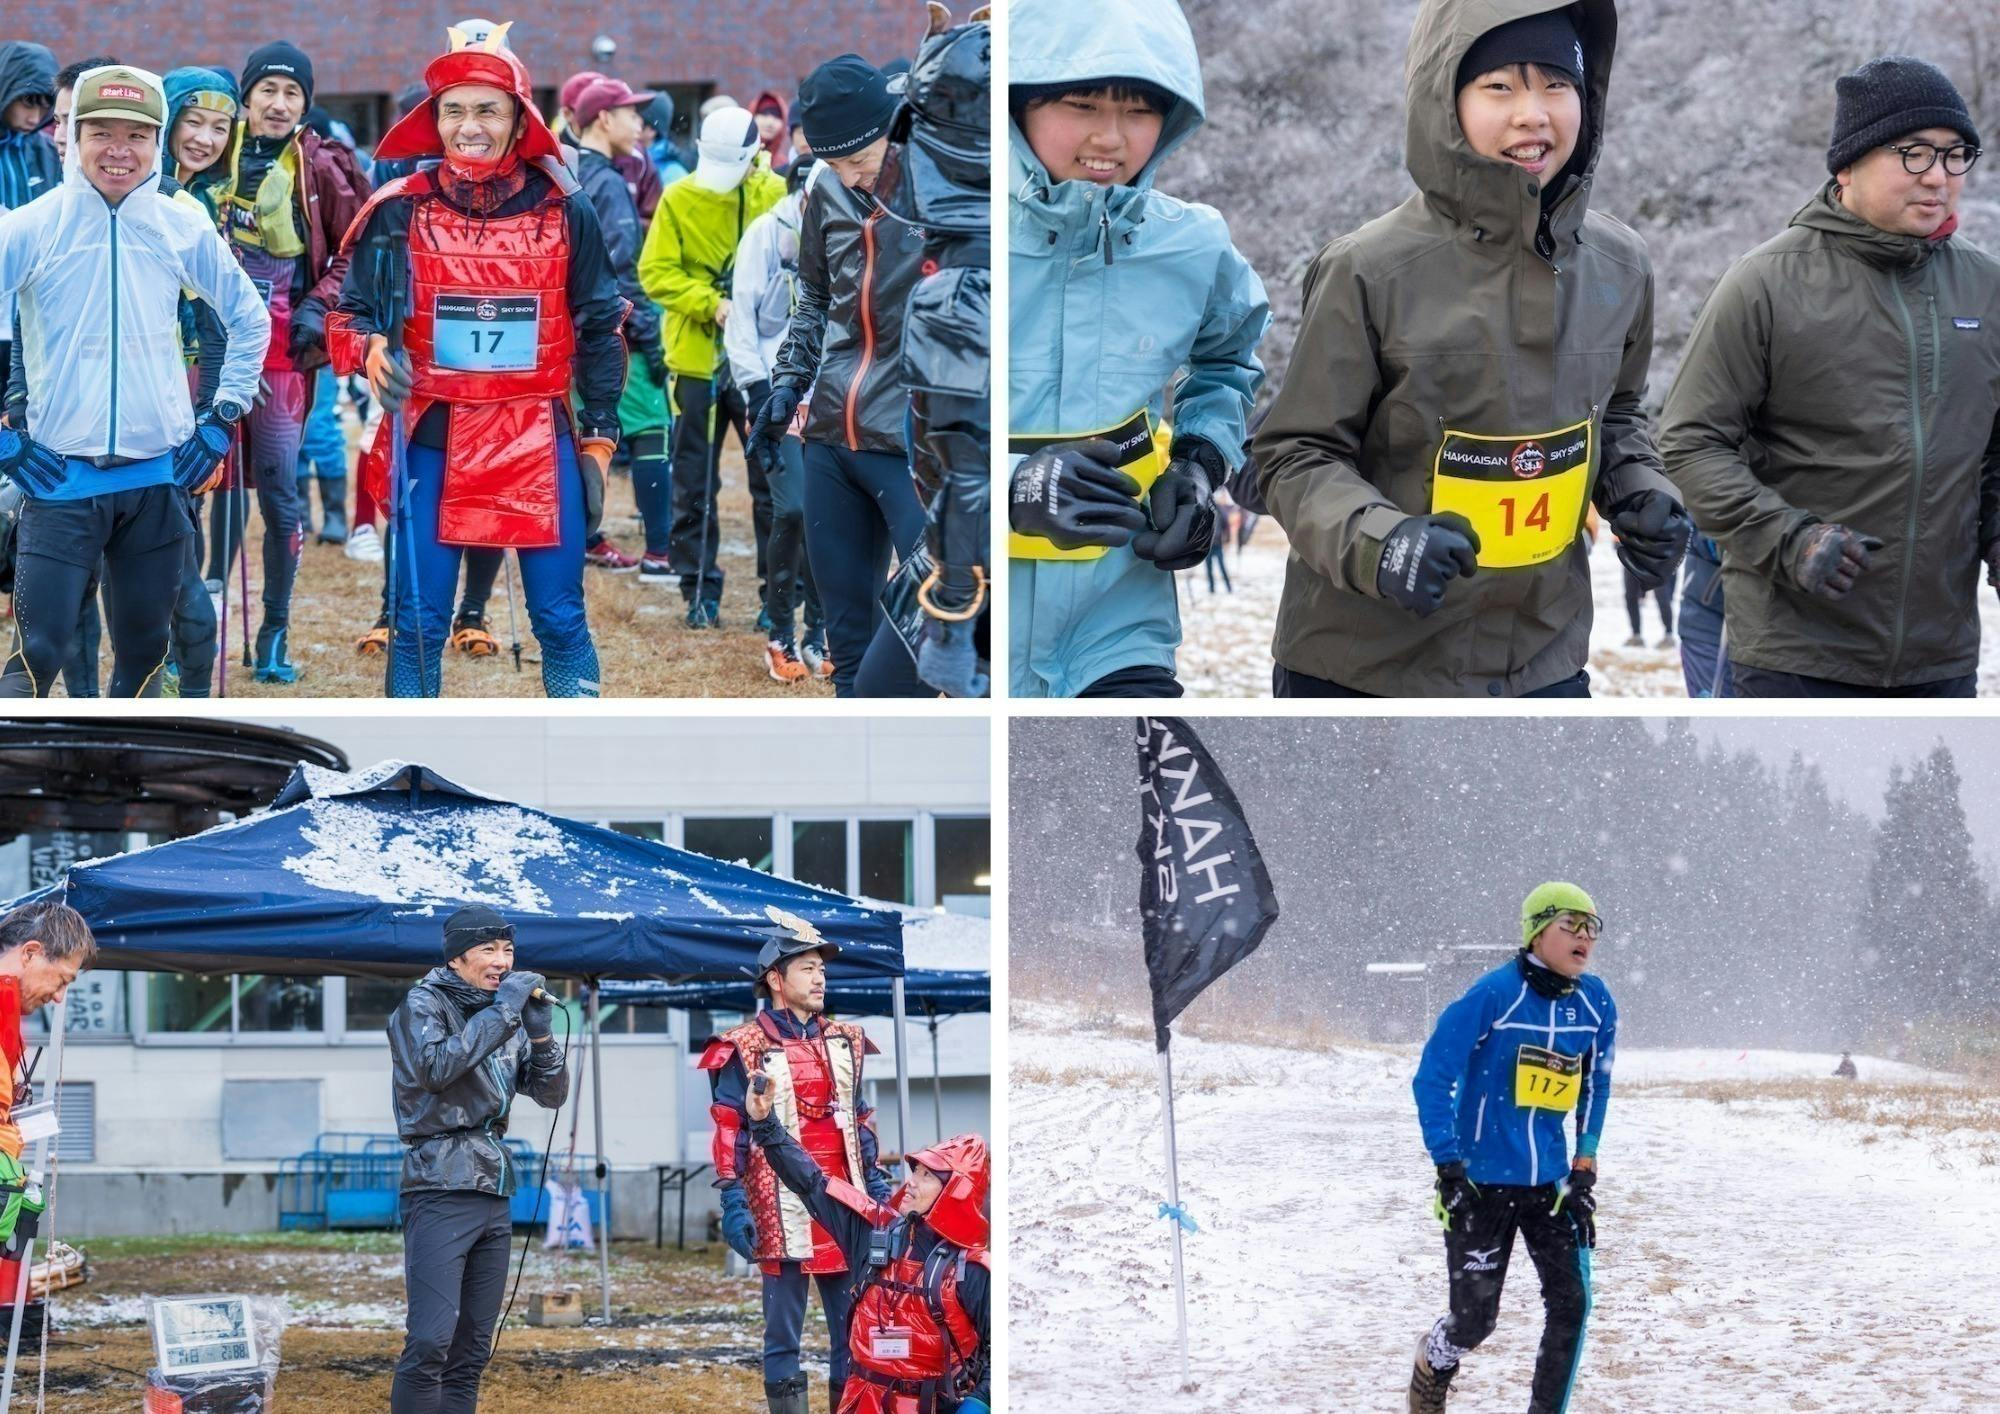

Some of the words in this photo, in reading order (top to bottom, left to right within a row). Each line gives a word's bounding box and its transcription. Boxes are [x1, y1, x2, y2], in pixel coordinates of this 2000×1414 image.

[102, 87, 123, 97] Start
[123, 88, 141, 99] Line
[811, 136, 864, 153] SALOMON
[438, 305, 475, 313] HAKKAISAN
[470, 330, 505, 354] 17
[1131, 429, 1149, 447] SNOW
[1443, 450, 1508, 466] HAKKAISAN
[1550, 447, 1567, 461] SKY
[1567, 439, 1587, 456] SNOW
[1498, 492, 1550, 537] 14
[1529, 1073, 1569, 1097] 117
